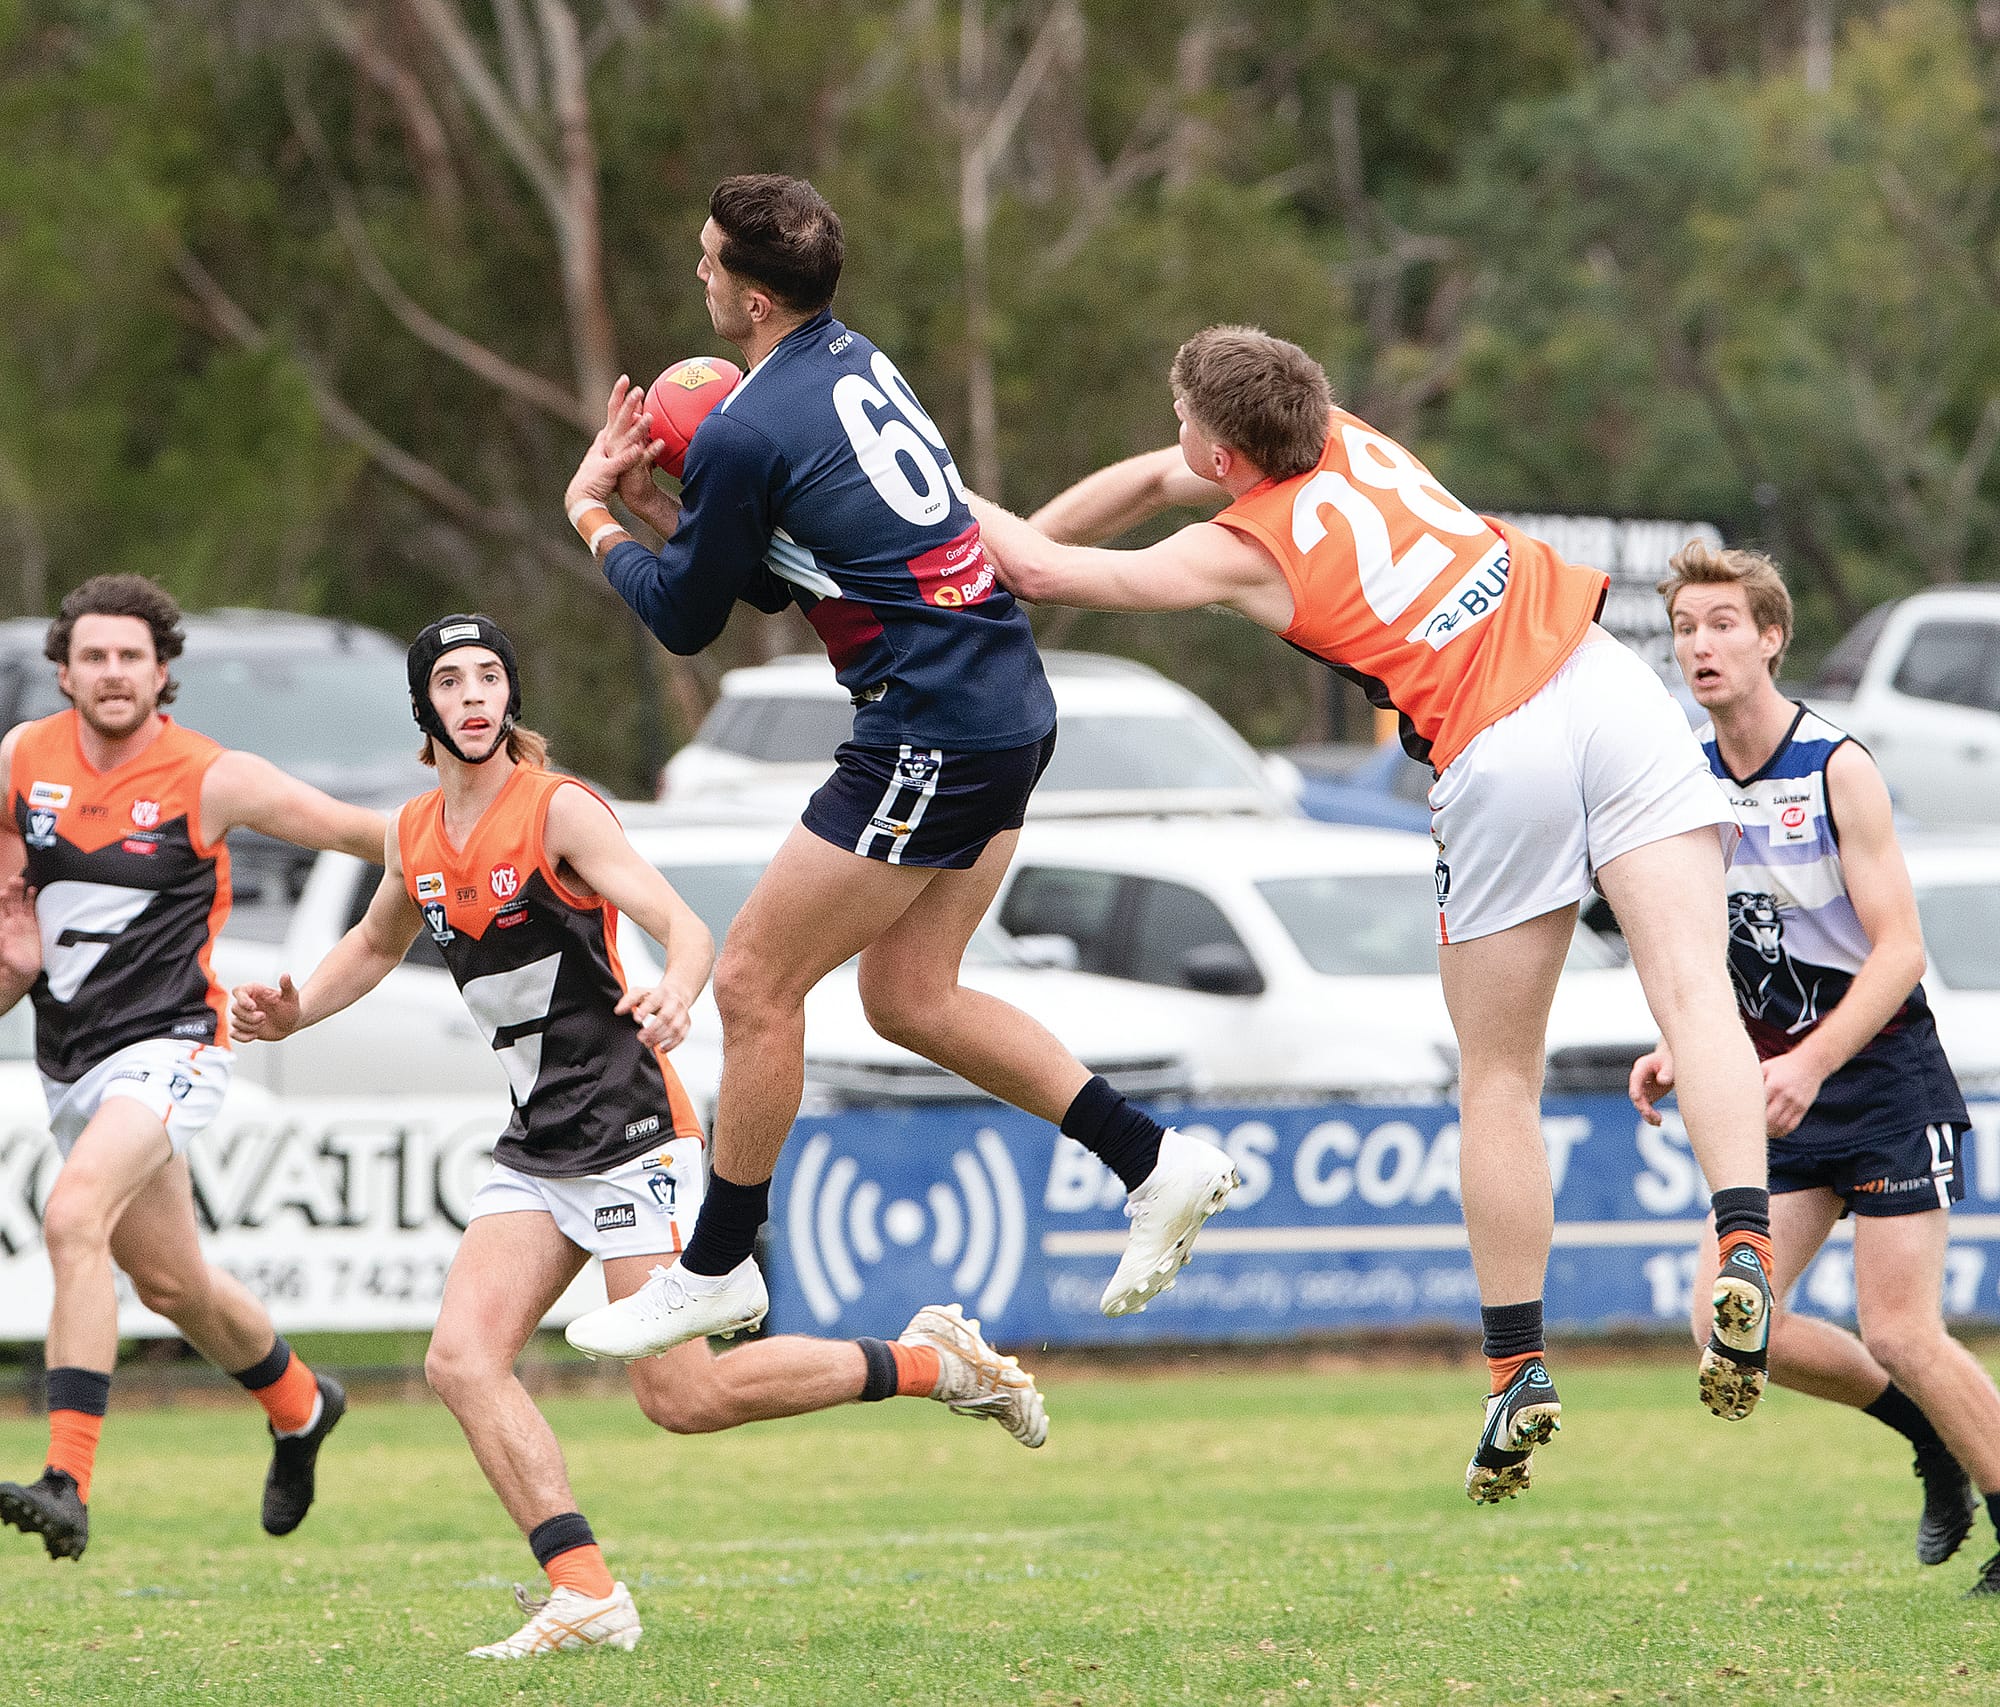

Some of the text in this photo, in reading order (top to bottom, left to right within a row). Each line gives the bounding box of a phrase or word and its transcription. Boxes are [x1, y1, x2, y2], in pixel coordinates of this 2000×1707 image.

[1292, 424, 1488, 626] 28
[456, 890, 477, 901] SWD
[628, 1119, 657, 1137] SWD
[1294, 1116, 1592, 1208] COAT
